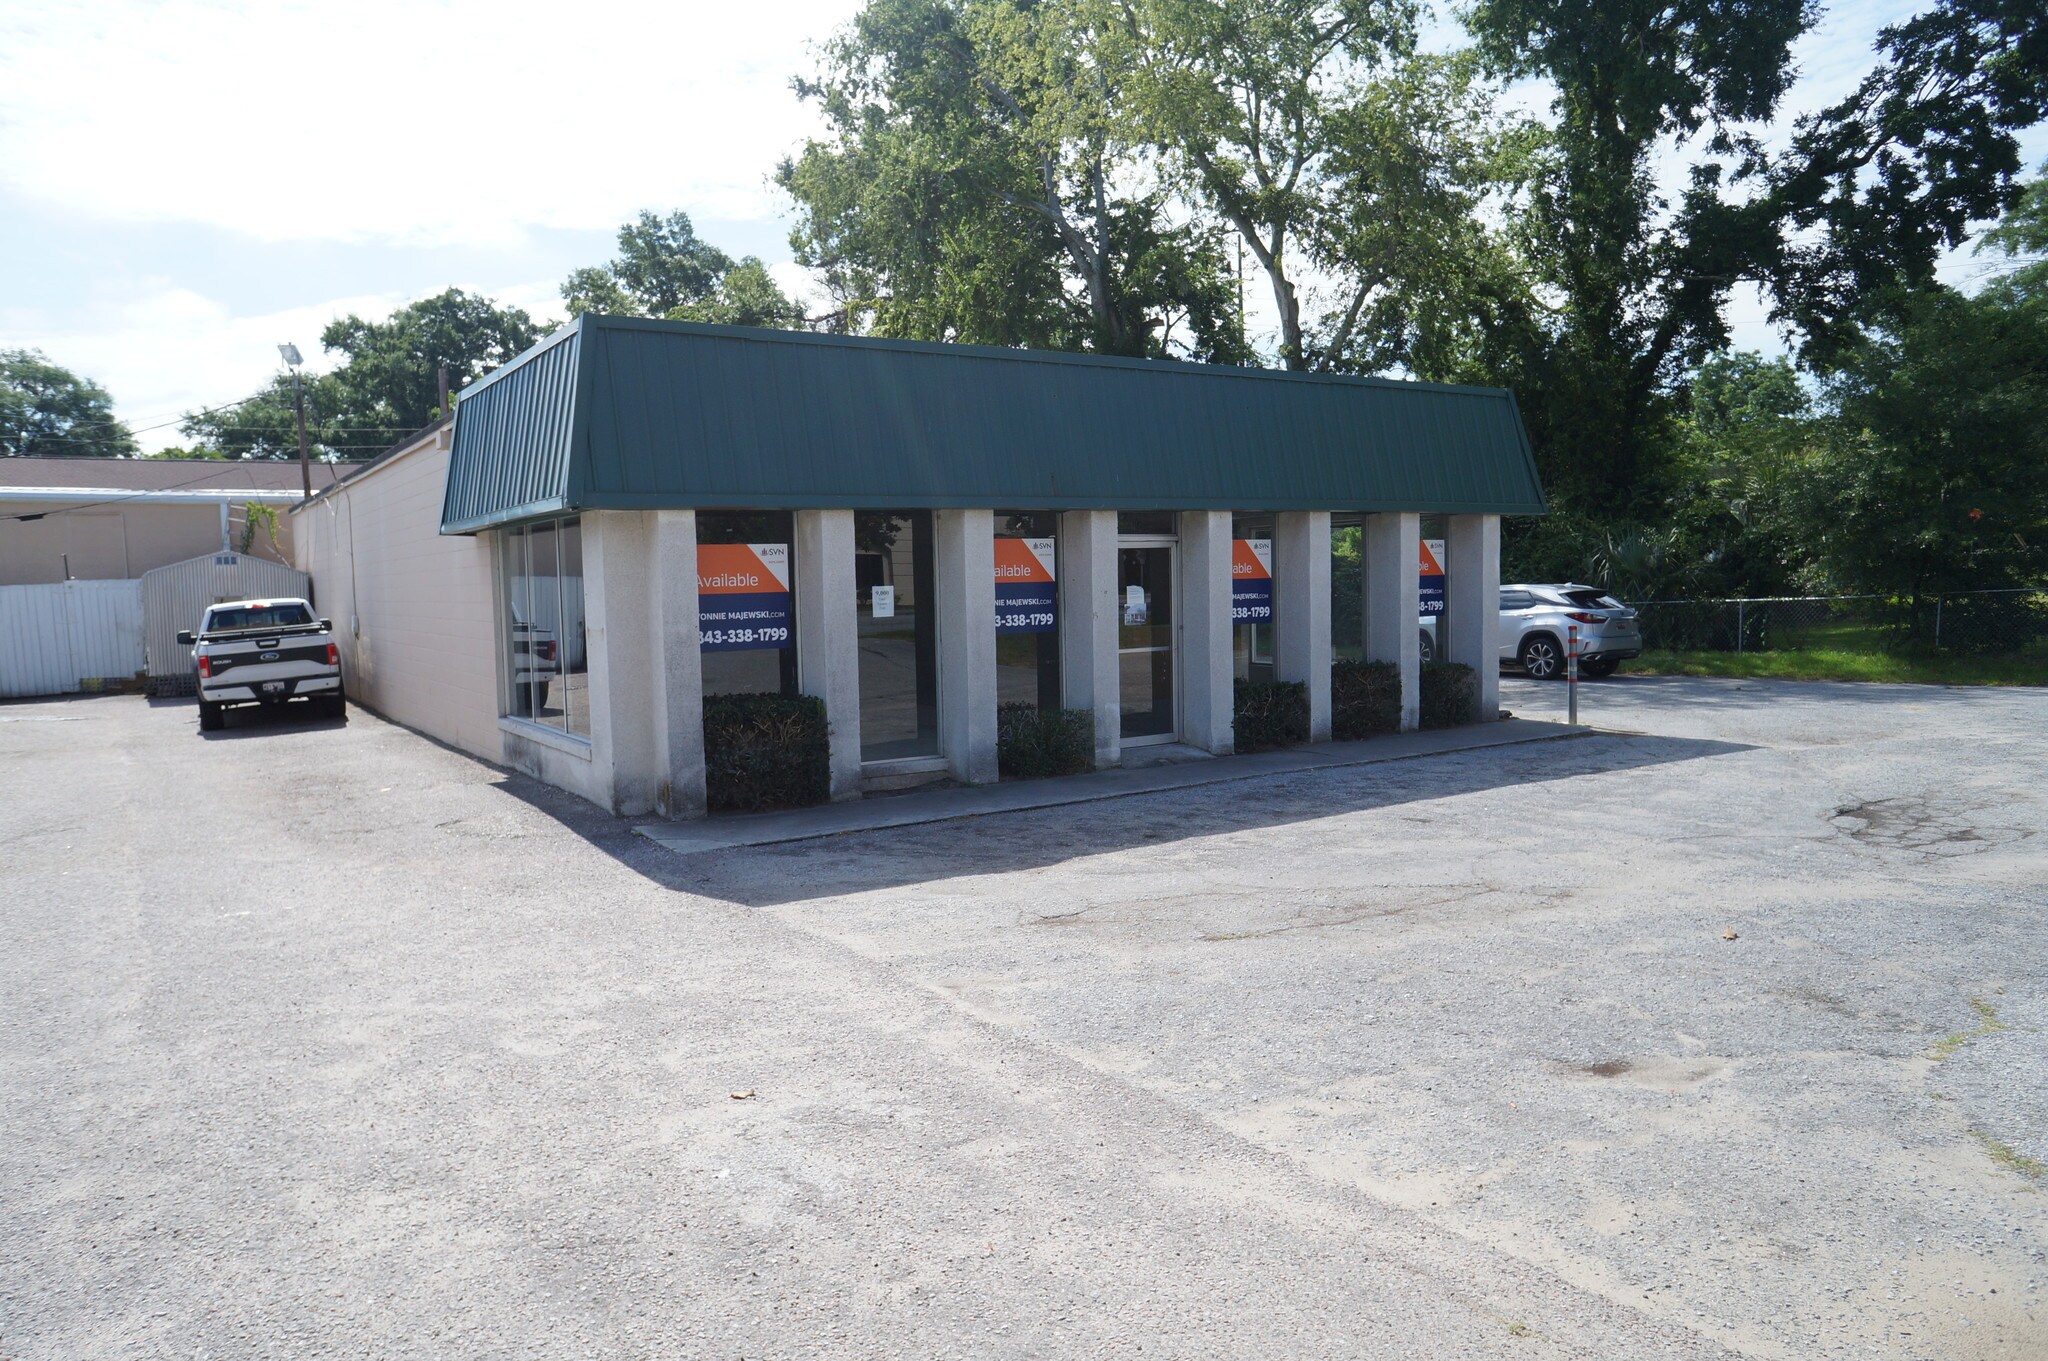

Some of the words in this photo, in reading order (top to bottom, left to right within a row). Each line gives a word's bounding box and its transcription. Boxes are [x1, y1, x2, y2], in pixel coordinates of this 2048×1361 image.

[768, 548, 784, 556] SVN
[994, 564, 1031, 577] ailable
[1232, 563, 1253, 574] able
[697, 573, 759, 588] Available
[1419, 601, 1443, 612] 8-1799
[699, 612, 727, 621] ONNIE
[995, 613, 1054, 627] 3-338-1799
